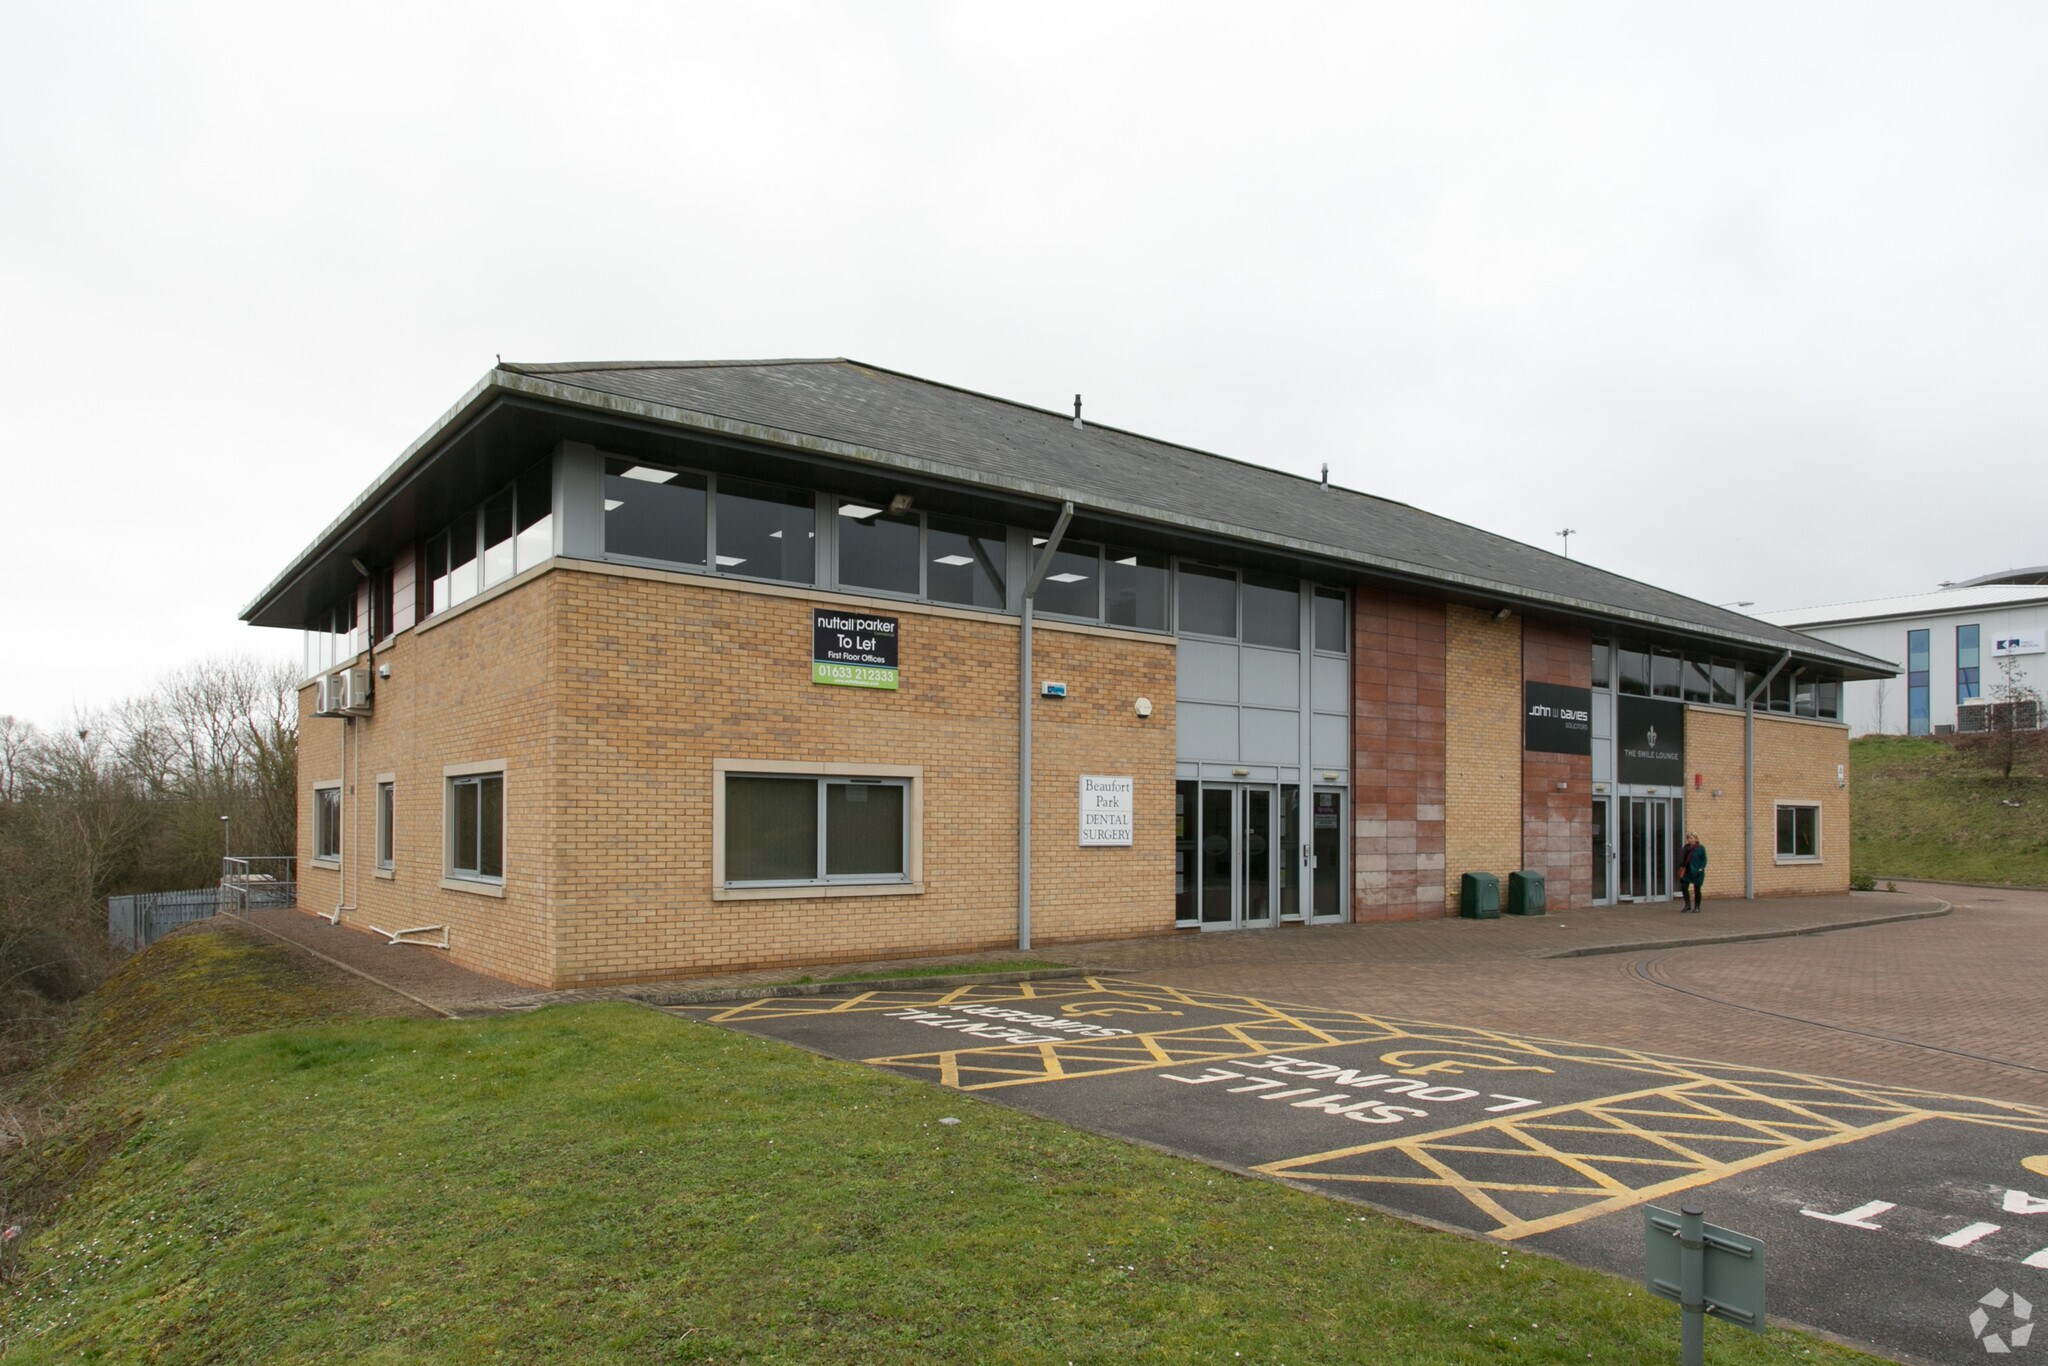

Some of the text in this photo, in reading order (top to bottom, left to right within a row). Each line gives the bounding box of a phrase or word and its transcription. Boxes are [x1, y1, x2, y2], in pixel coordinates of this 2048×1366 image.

[817, 616, 895, 633] nuttall parker
[837, 633, 876, 651] To Let
[828, 650, 885, 663] First Floor Offices
[818, 665, 894, 682] 01633 212333
[1624, 749, 1679, 760] THE SMILE LOUNGE
[1085, 779, 1130, 792] Beaufort
[1096, 795, 1119, 807] Park
[1086, 814, 1129, 825] DENTAL
[1083, 829, 1131, 840] SURGERY
[883, 1008, 1065, 1044] DENTAL
[938, 1004, 1133, 1037] SURGERY
[1228, 1055, 1542, 1112] LOUNGE
[1159, 1067, 1429, 1124] SMILE
